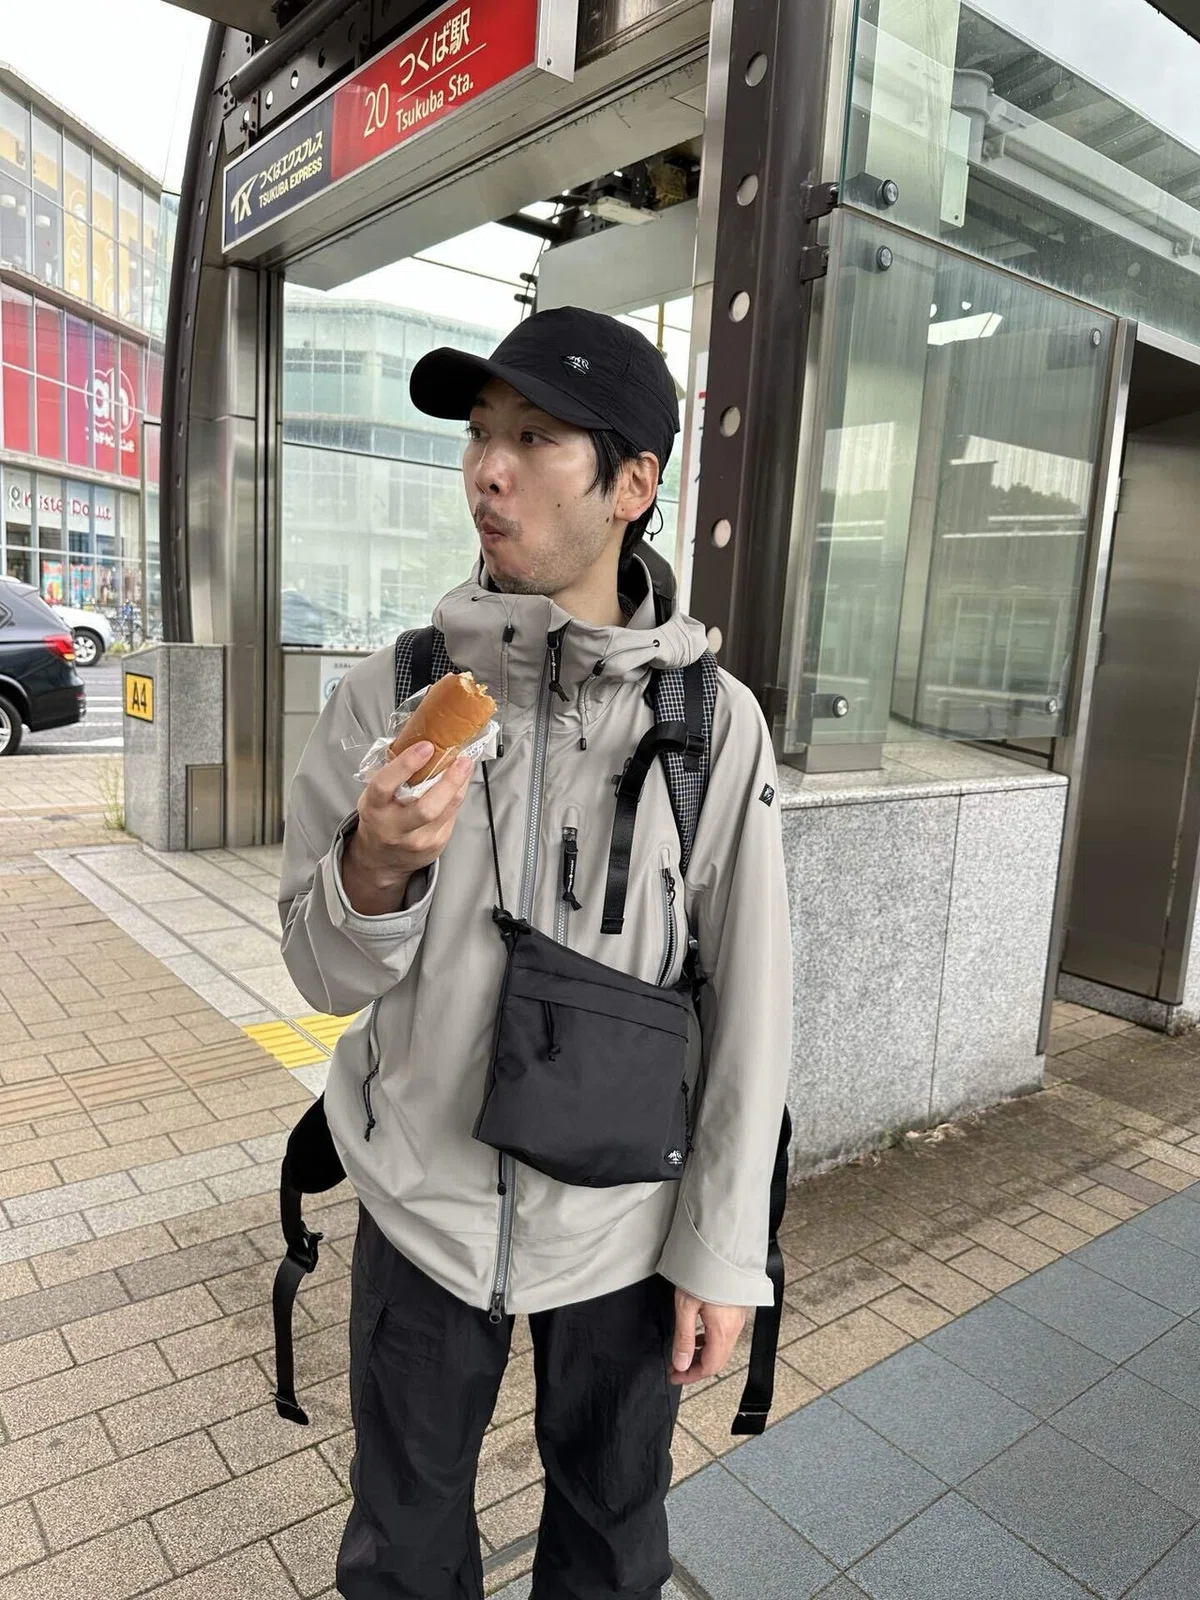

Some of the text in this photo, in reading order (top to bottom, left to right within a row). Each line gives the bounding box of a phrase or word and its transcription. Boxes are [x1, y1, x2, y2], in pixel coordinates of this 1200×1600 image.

[399, 7, 471, 86] つくば駅
[363, 82, 389, 137] 20
[396, 73, 474, 133] Tsukuba Sta.
[258, 156, 323, 208] TSUKUBA EXPRESS
[259, 130, 323, 189] つくばエクスプレス
[230, 173, 259, 224] TX
[131, 681, 147, 714] A4
